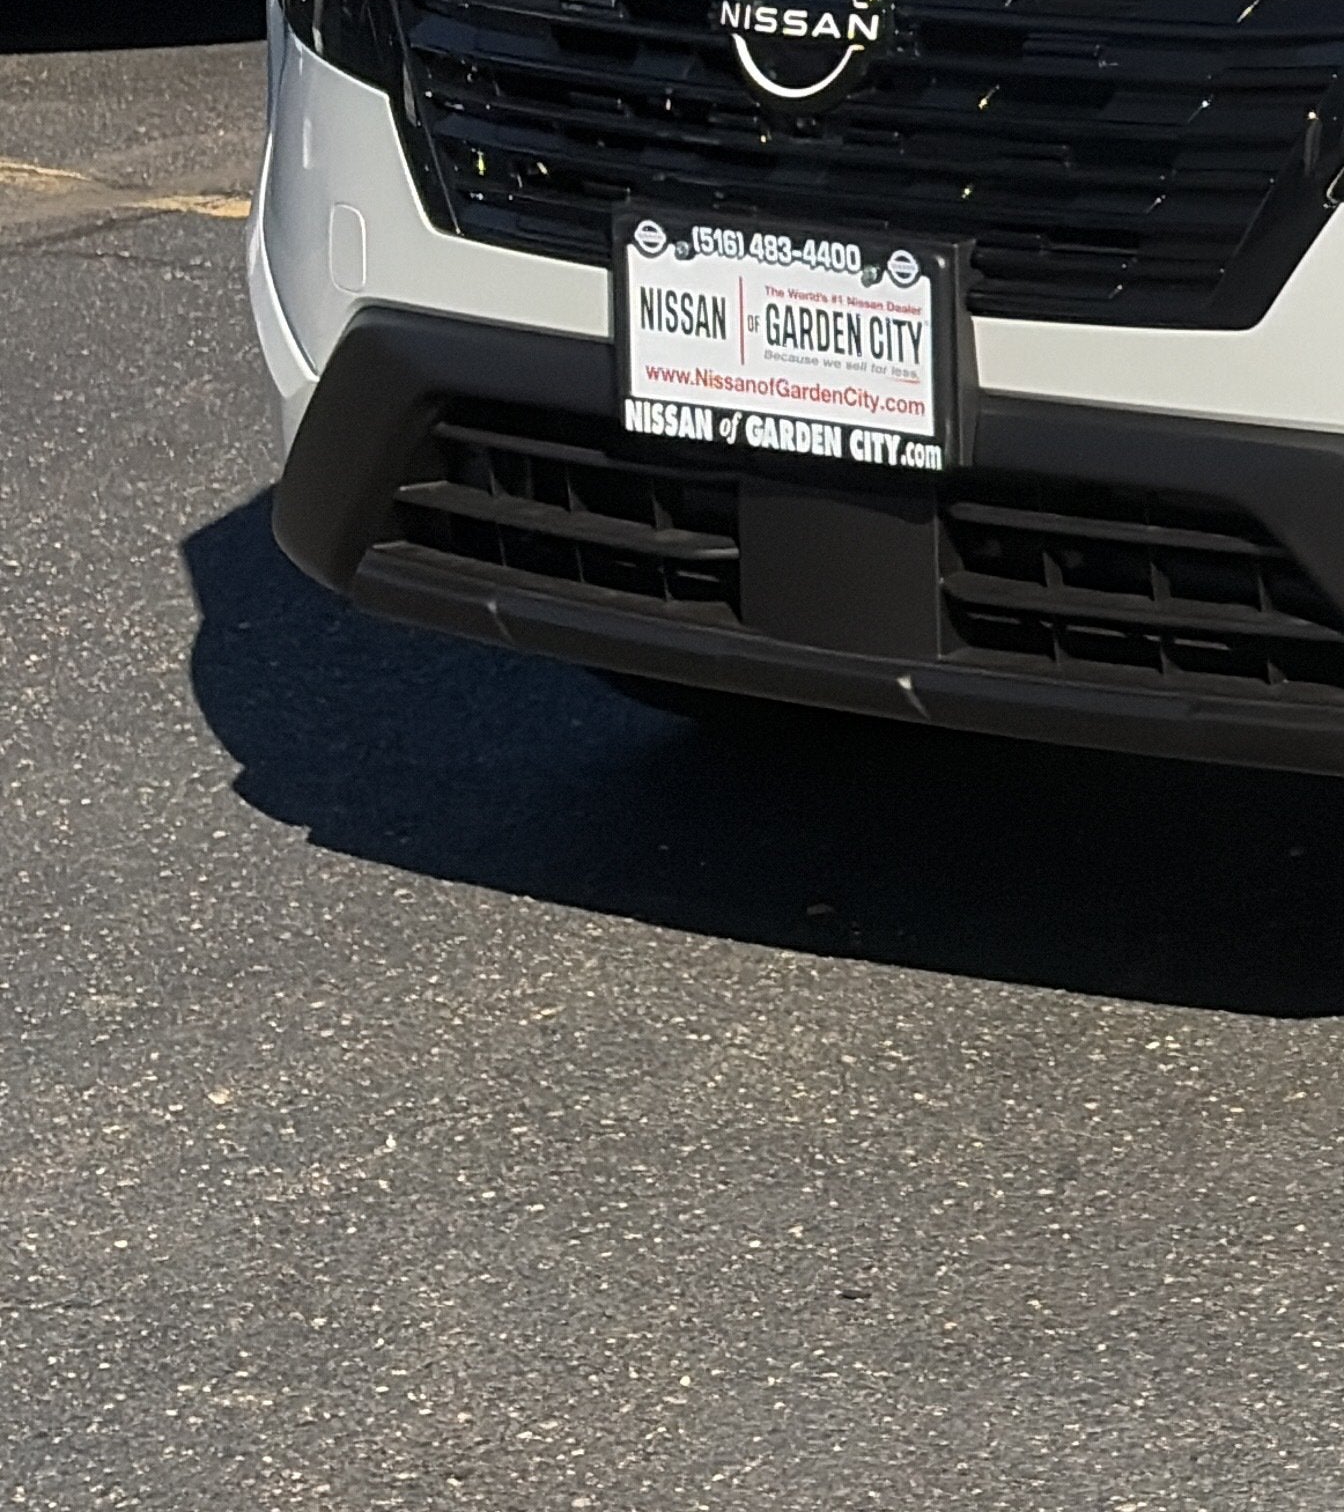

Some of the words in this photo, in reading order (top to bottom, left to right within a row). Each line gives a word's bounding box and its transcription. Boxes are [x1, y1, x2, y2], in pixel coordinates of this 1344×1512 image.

[720, 0, 879, 40] NISSAN
[692, 226, 744, 257] (516)
[750, 233, 861, 271] 483-4400
[765, 286, 784, 298] The
[788, 289, 828, 303] World's
[831, 295, 843, 305] #1
[847, 297, 883, 310] Nissan
[886, 301, 922, 315] Dealer
[640, 286, 727, 340] NISSAN
[747, 314, 760, 333] OF
[766, 303, 862, 357] GARDEN
[869, 316, 923, 364] CITY
[764, 350, 819, 366] Because
[823, 359, 841, 369] we
[845, 361, 868, 373] sell
[871, 363, 887, 376] for
[645, 365, 925, 416] www.NissanofGardenCity.com
[624, 398, 714, 441] NISSAN
[719, 411, 743, 445] of
[745, 414, 843, 458] GARDEN
